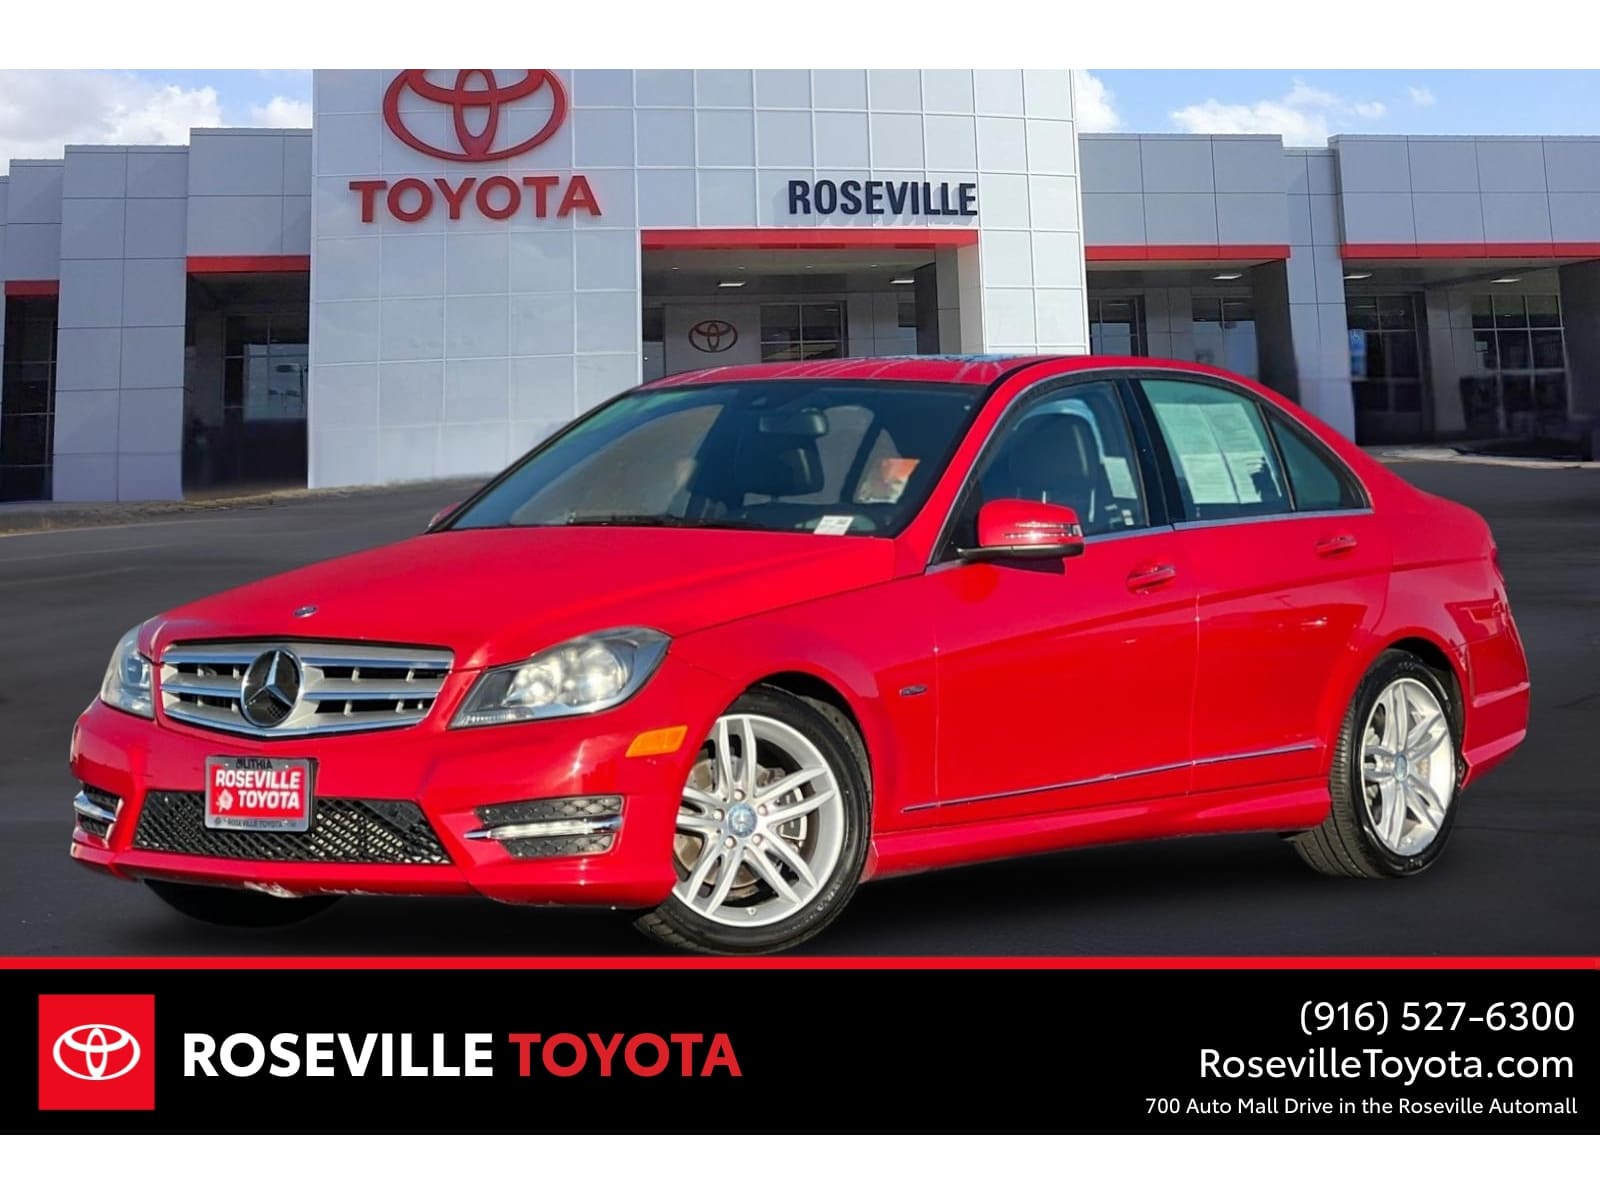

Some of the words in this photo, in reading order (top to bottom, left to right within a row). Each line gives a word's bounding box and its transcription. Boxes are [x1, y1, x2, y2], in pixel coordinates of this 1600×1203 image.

[350, 175, 602, 223] TOYOTA
[788, 180, 978, 216] ROSEVILLE
[243, 759, 272, 769] LITHIA
[215, 769, 301, 789] ROSEVILLE
[238, 790, 300, 810] TOYOTA
